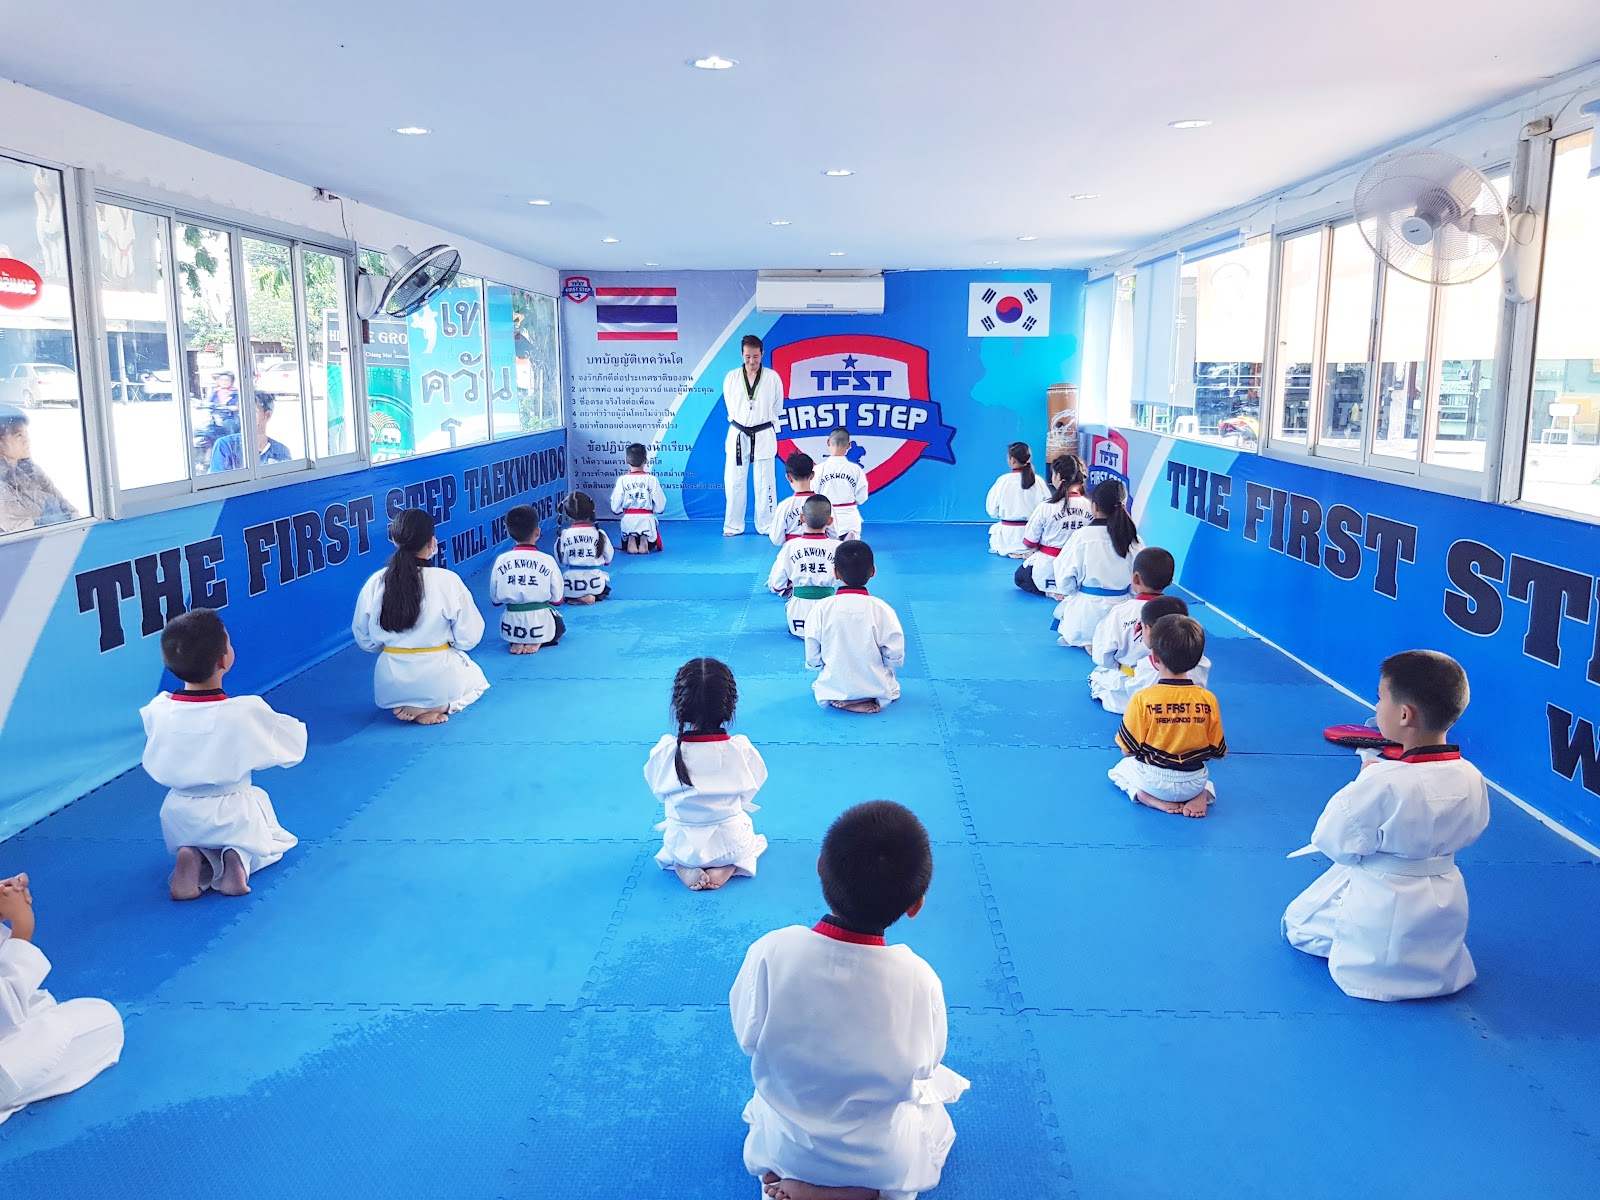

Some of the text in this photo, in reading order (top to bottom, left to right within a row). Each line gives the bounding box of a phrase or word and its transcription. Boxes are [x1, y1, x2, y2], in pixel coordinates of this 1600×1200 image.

[811, 370, 891, 391] TFST
[775, 403, 928, 434] FIRST STEP
[1166, 460, 1232, 531] THE
[1242, 480, 1418, 600] FIRST
[75, 535, 229, 654] THE
[243, 494, 375, 597] FIRST
[464, 445, 566, 514] TAEKWONDO
[451, 526, 488, 566] WILL
[803, 546, 827, 558] KWON
[497, 558, 551, 577] TAE KWON DO
[501, 621, 545, 639] RDC
[1146, 703, 1163, 715] THE
[1166, 703, 1191, 714] FIRST
